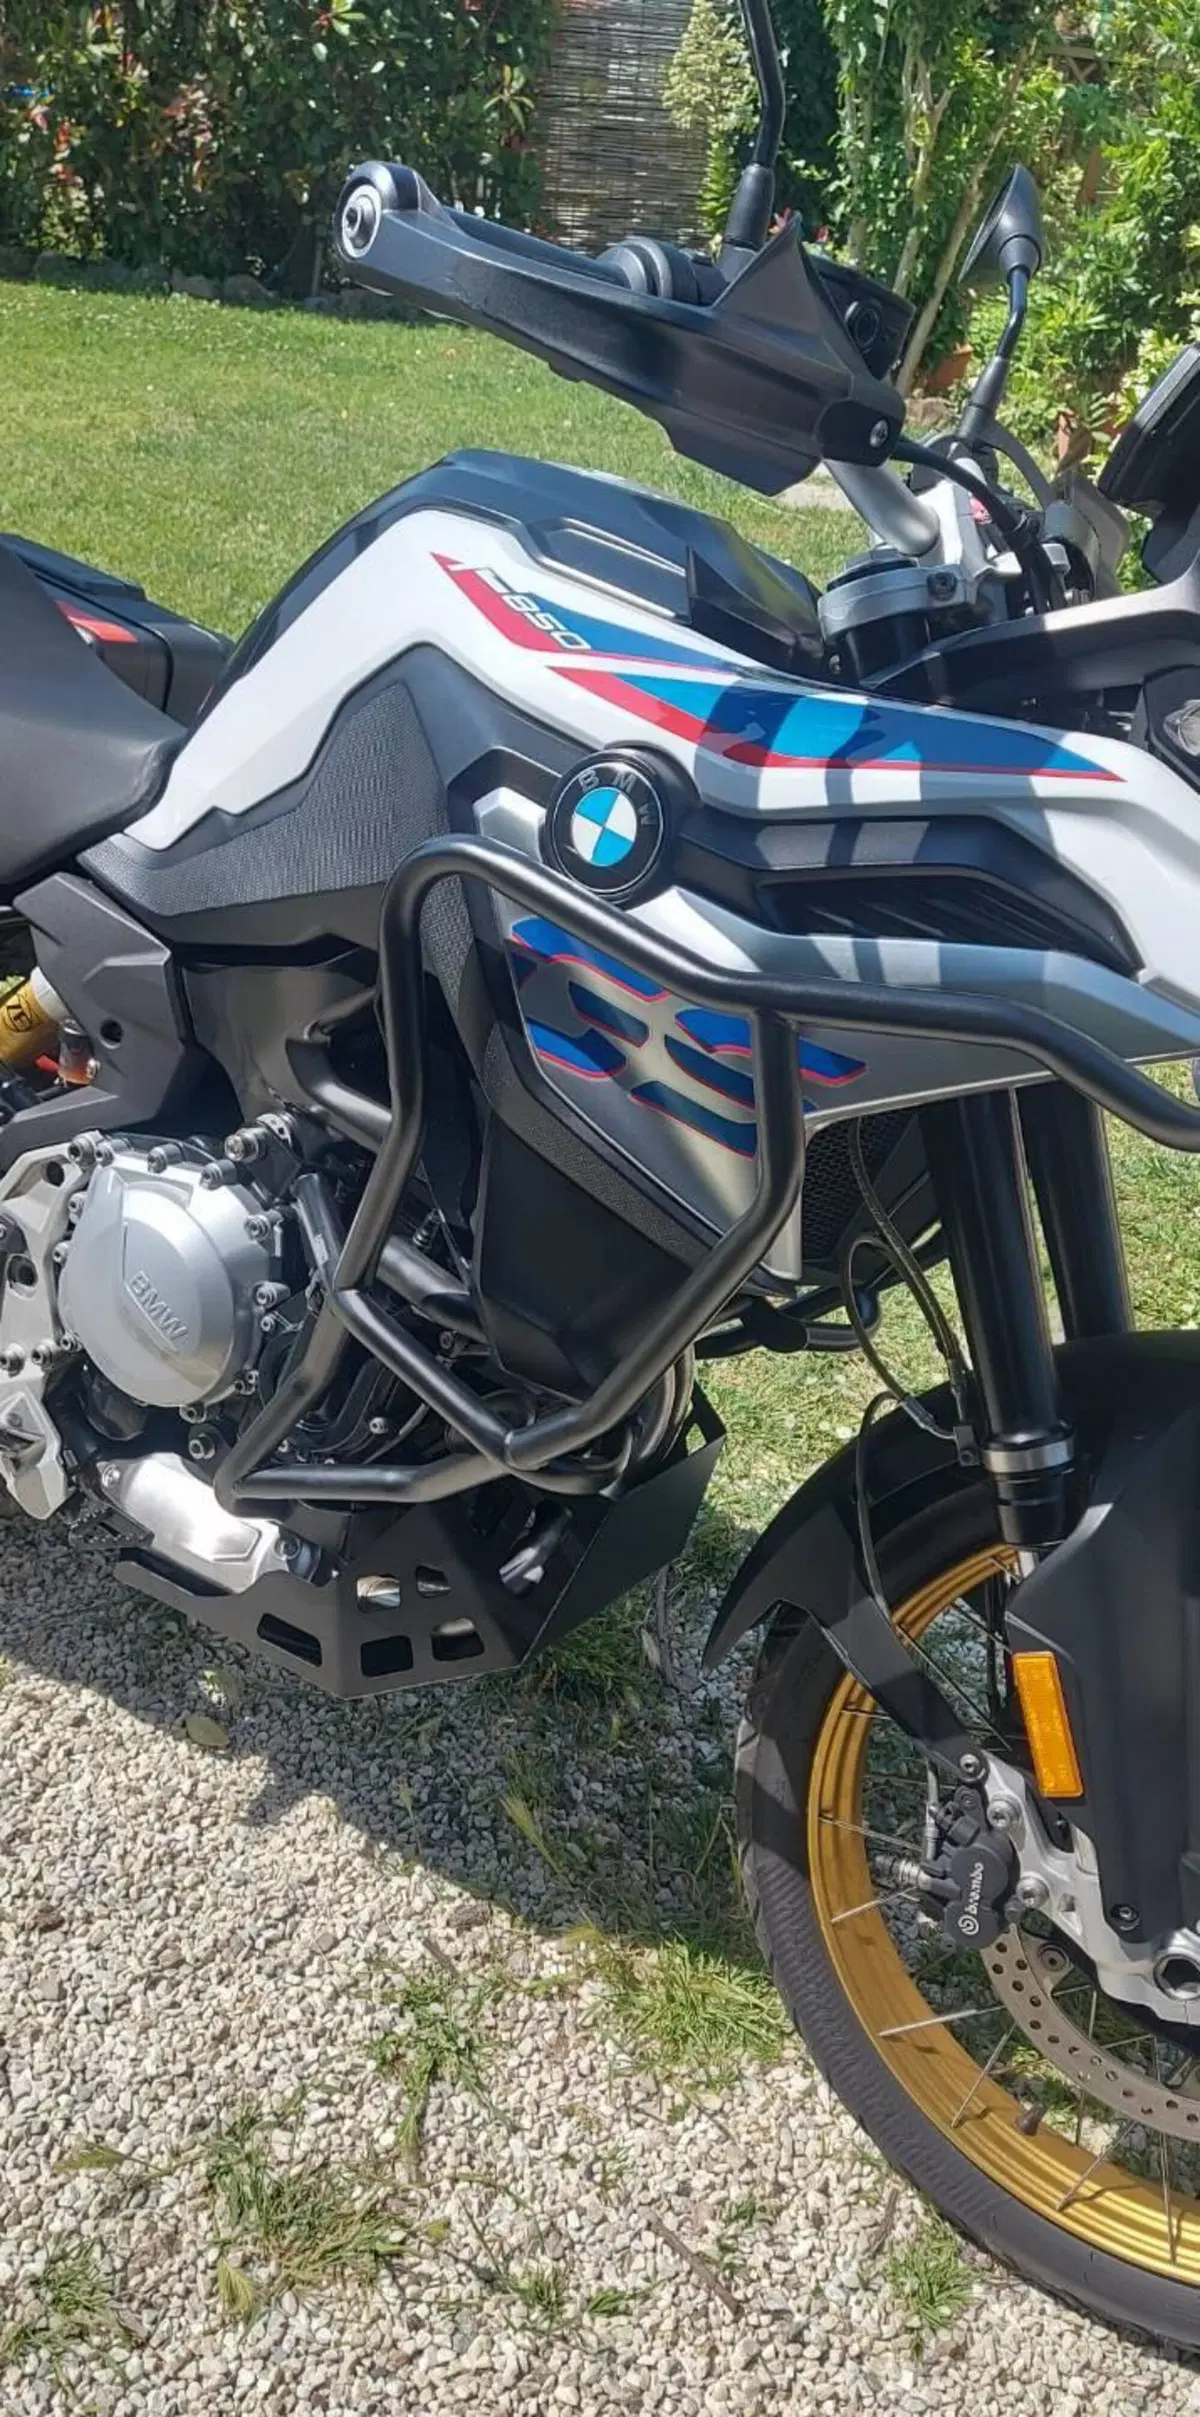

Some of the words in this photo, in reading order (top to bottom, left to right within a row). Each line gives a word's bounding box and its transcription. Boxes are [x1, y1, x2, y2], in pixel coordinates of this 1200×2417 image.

[578, 769, 657, 826] BMW
[127, 1269, 189, 1342] BMW
[964, 1861, 985, 1915] brembo
